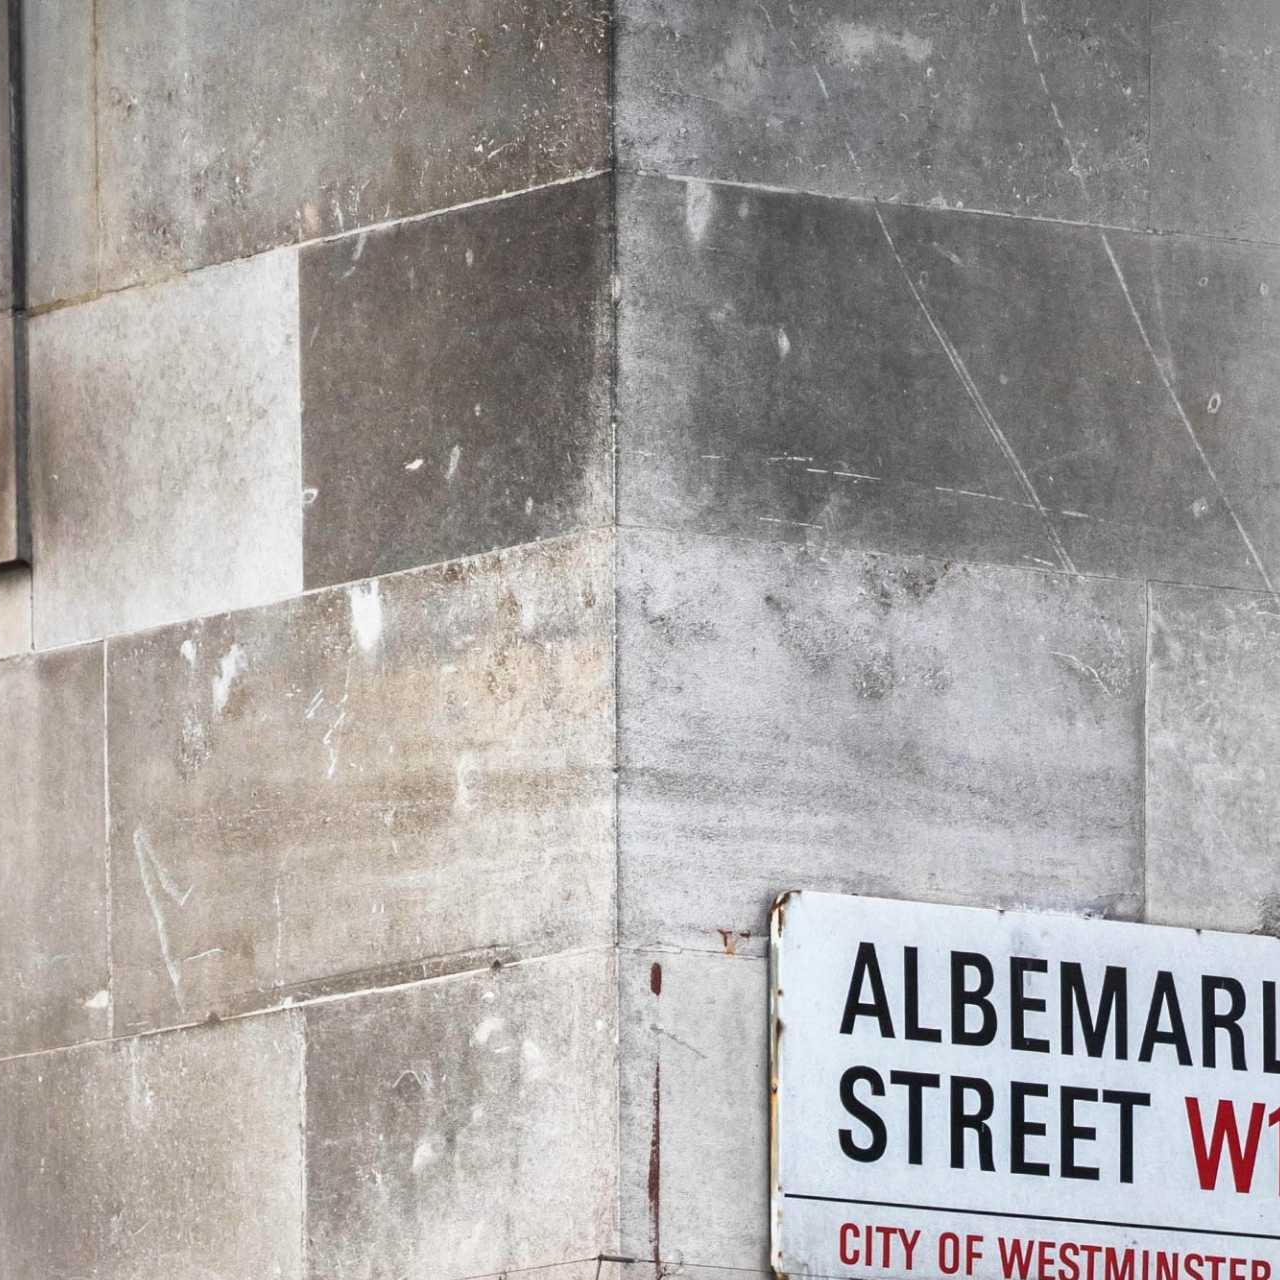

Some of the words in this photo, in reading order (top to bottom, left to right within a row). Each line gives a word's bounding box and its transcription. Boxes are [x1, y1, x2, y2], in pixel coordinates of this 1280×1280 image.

[838, 1065, 1151, 1184] STREET
[839, 1223, 921, 1270] CITY
[938, 1231, 984, 1276] OF
